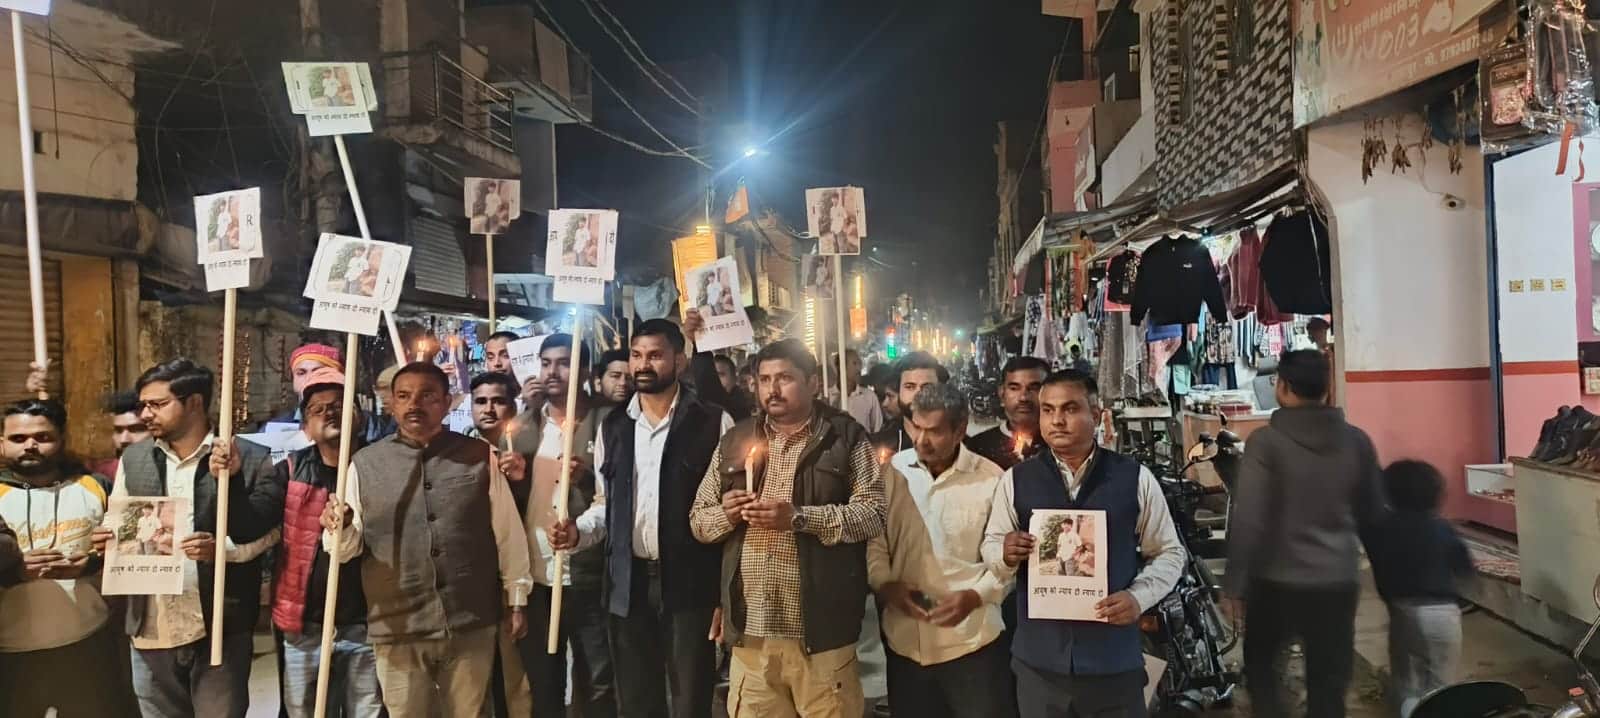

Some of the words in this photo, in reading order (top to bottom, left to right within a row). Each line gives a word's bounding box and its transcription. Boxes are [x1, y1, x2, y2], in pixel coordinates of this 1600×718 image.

[110, 566, 125, 576] आयुष
[128, 564, 134, 573] को
[152, 564, 158, 573] दो
[175, 565, 180, 573] दो
[1033, 587, 1047, 597] आयुष
[1049, 586, 1057, 594] को
[1058, 587, 1073, 595] न्याय
[1074, 587, 1080, 596] दो
[1082, 588, 1096, 597] न्याय
[1097, 589, 1103, 597] दो
